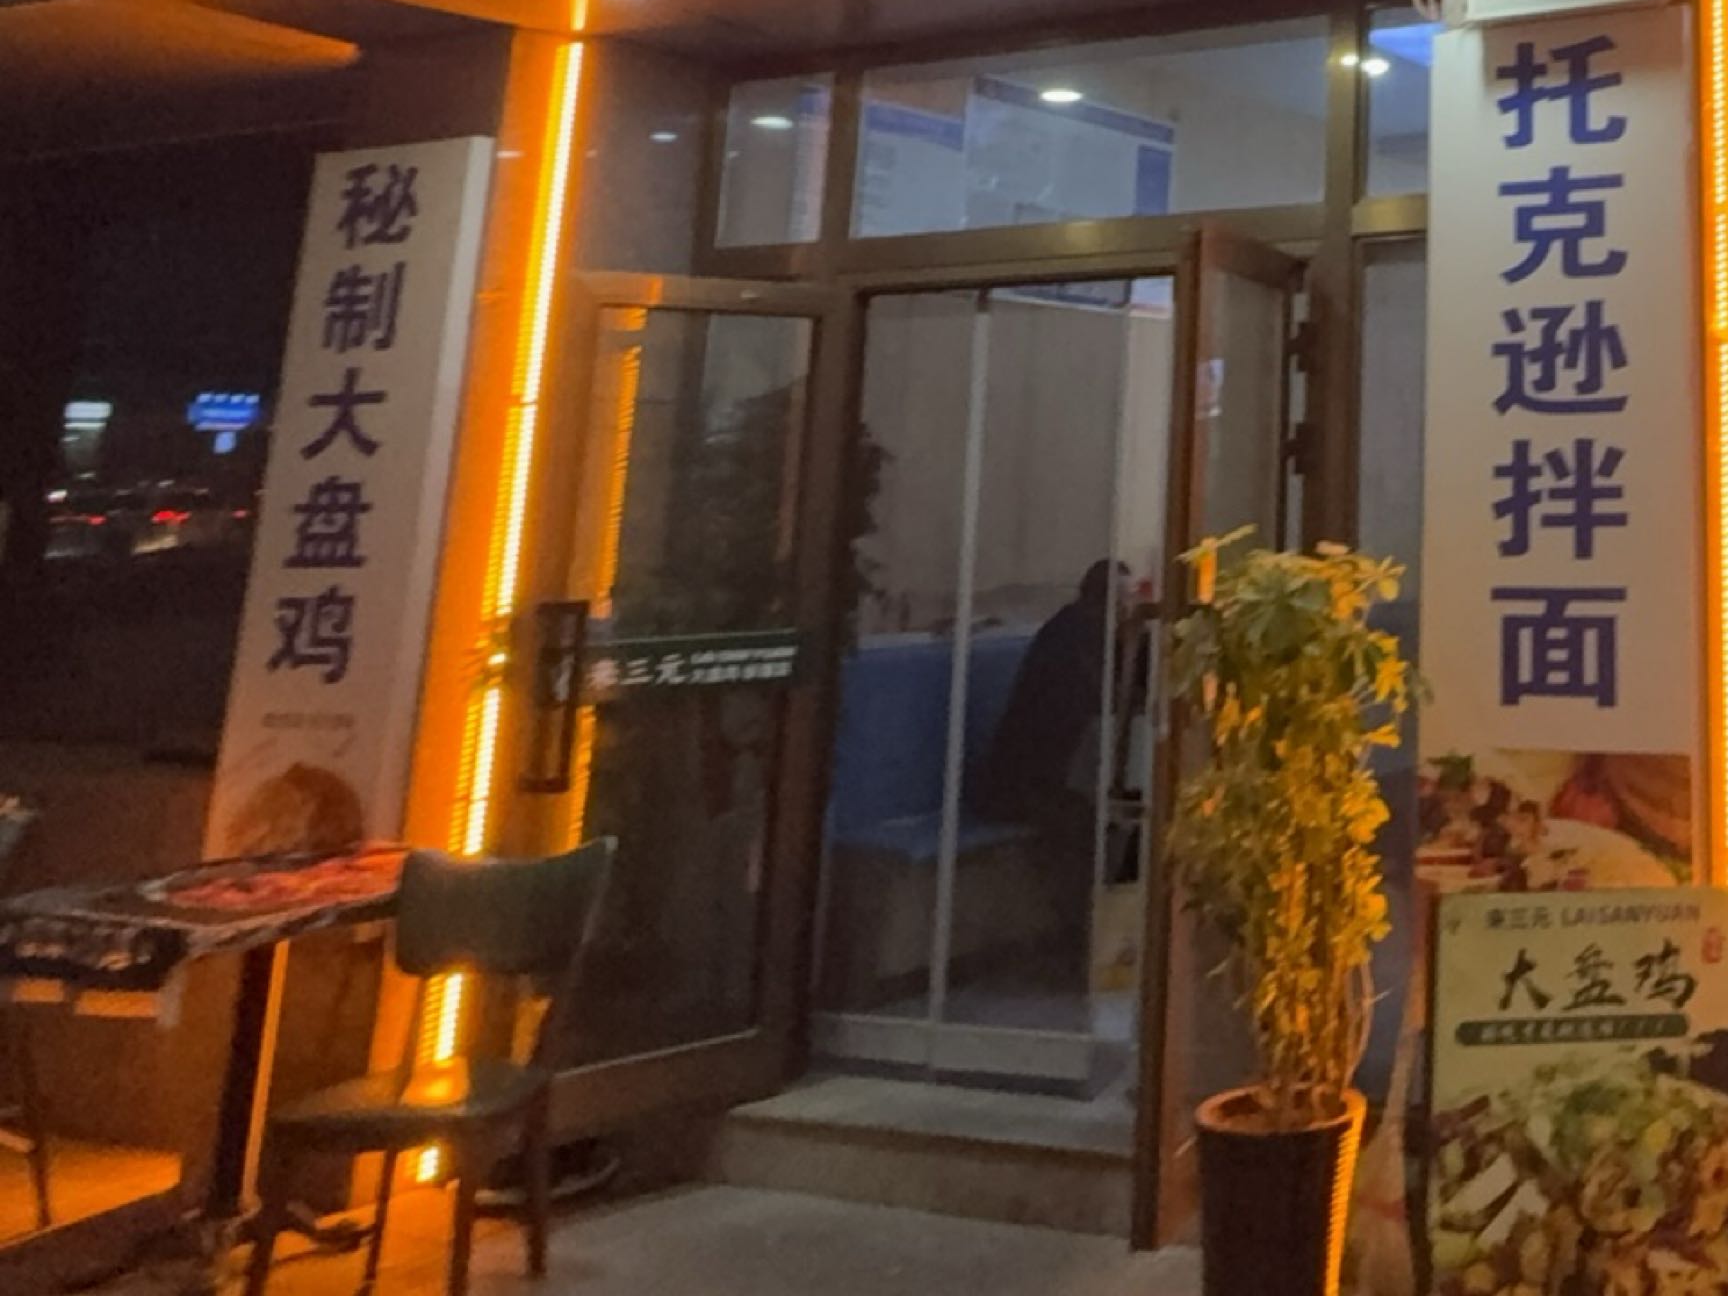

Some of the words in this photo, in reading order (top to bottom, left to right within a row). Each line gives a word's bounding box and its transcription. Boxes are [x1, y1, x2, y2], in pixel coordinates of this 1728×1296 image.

[266, 161, 421, 686] 秘制大盘鸡
[1490, 35, 1630, 707] 托克逊拌面
[1497, 936, 1698, 1011] 大盘鸡
